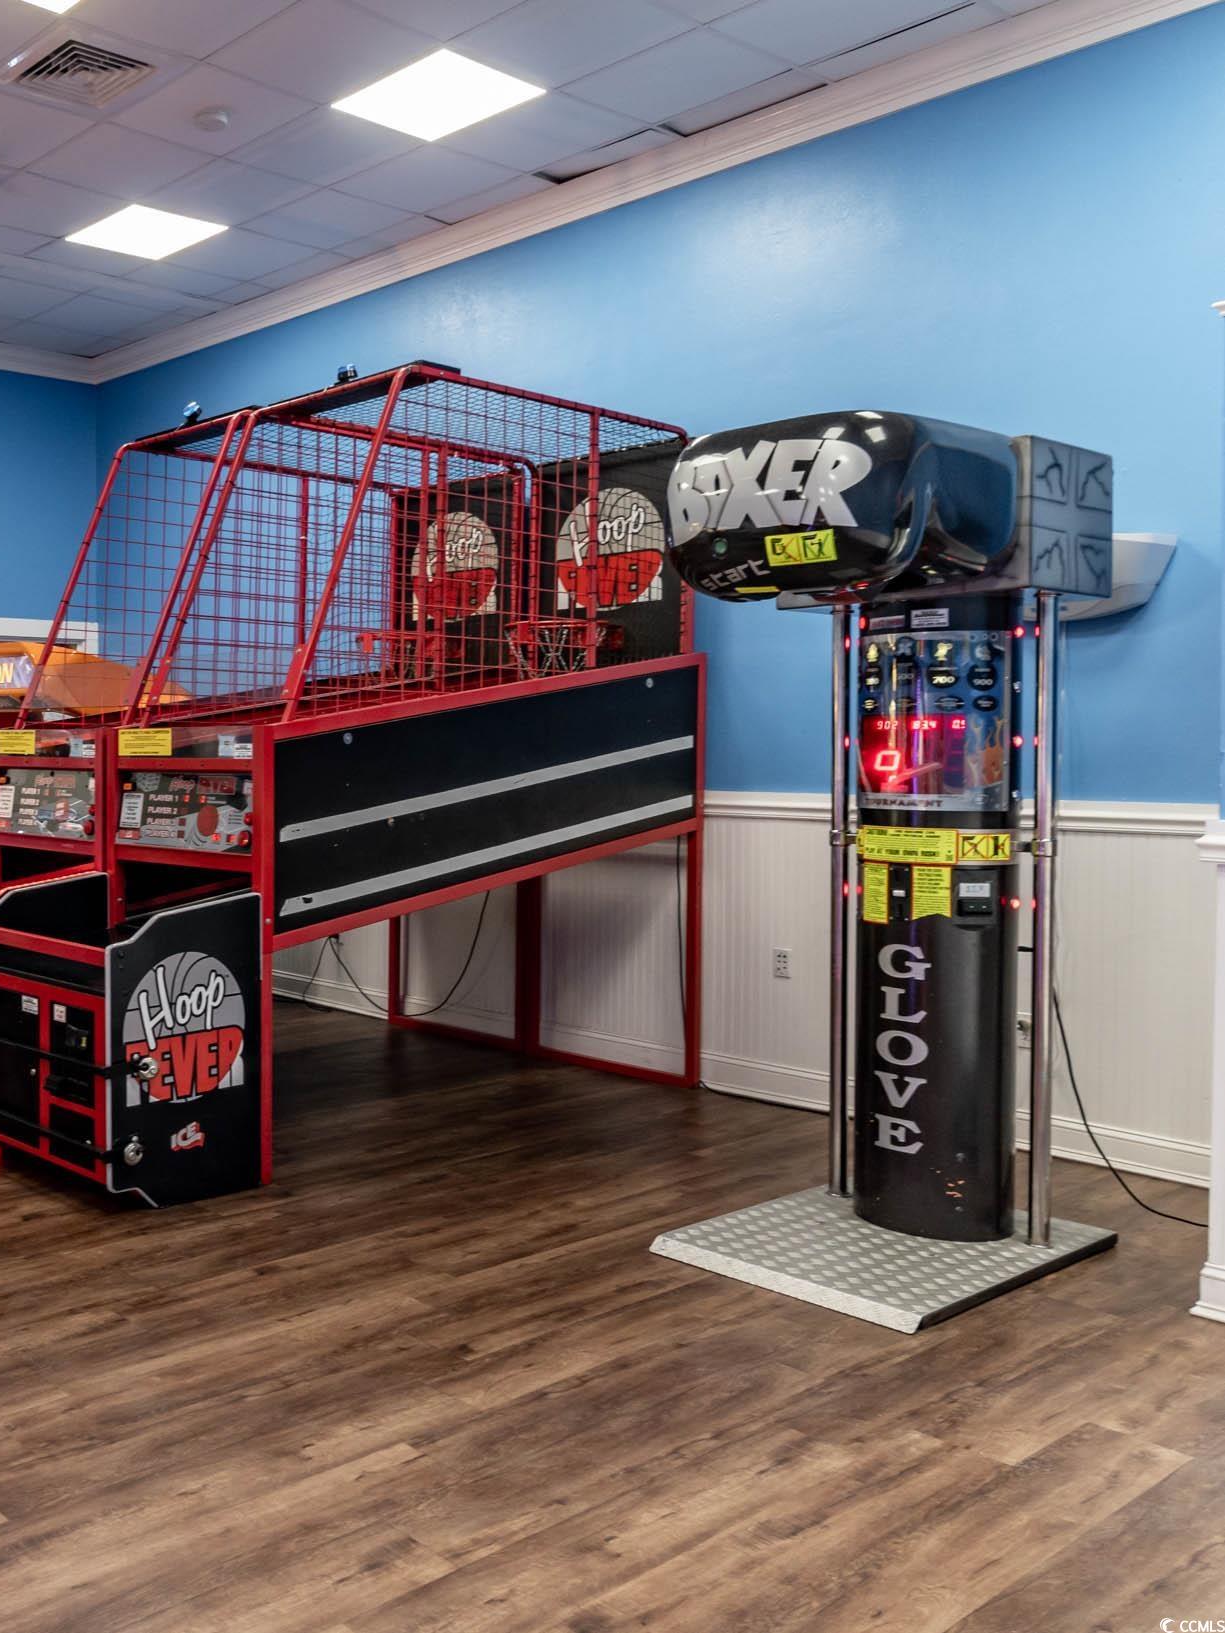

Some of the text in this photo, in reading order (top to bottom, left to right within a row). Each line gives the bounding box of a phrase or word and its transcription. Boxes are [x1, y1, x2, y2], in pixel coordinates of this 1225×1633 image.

[667, 438, 873, 549] BOXER
[700, 559, 771, 591] start
[932, 676, 956, 684] 700
[147, 806, 172, 814] PLAYER
[138, 965, 225, 1050] Hoop
[873, 944, 932, 1154] GLOVE
[170, 1121, 206, 1151] ICE
